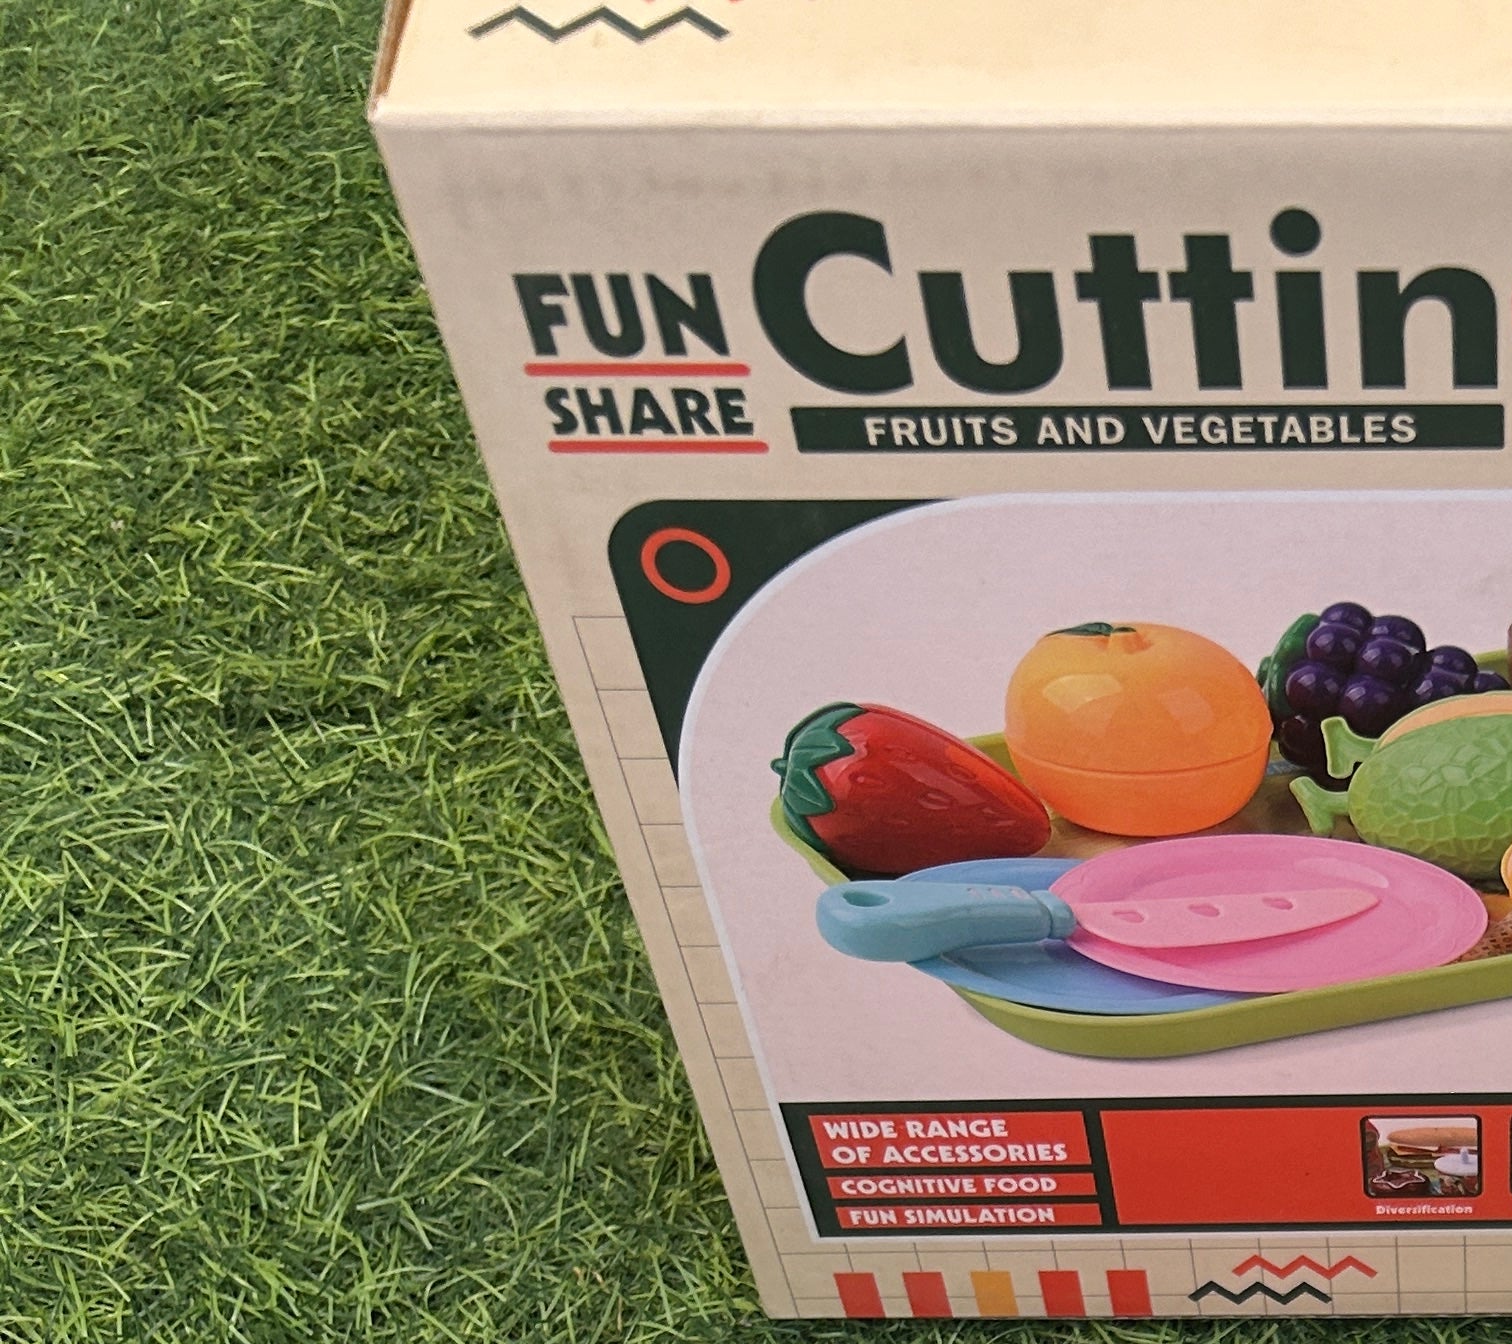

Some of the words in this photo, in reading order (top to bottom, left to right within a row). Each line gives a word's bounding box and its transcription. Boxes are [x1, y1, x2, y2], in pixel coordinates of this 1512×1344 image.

[512, 272, 731, 358] FUN
[543, 387, 755, 437] SHARE
[864, 415, 1018, 446] FRUITS
[1036, 415, 1126, 445] AND
[1142, 414, 1418, 444] VEGETABLES
[822, 1120, 898, 1140] WIDE
[906, 1119, 1009, 1139] RANGE
[831, 1145, 871, 1166] OF
[883, 1143, 1068, 1164] ACCESSORIES
[840, 1177, 977, 1196] COGNITIVE
[983, 1176, 1058, 1194] FOOD
[848, 1208, 898, 1226] FUN
[904, 1206, 1056, 1225] SIMULATION
[1375, 1204, 1474, 1216] Diversification
